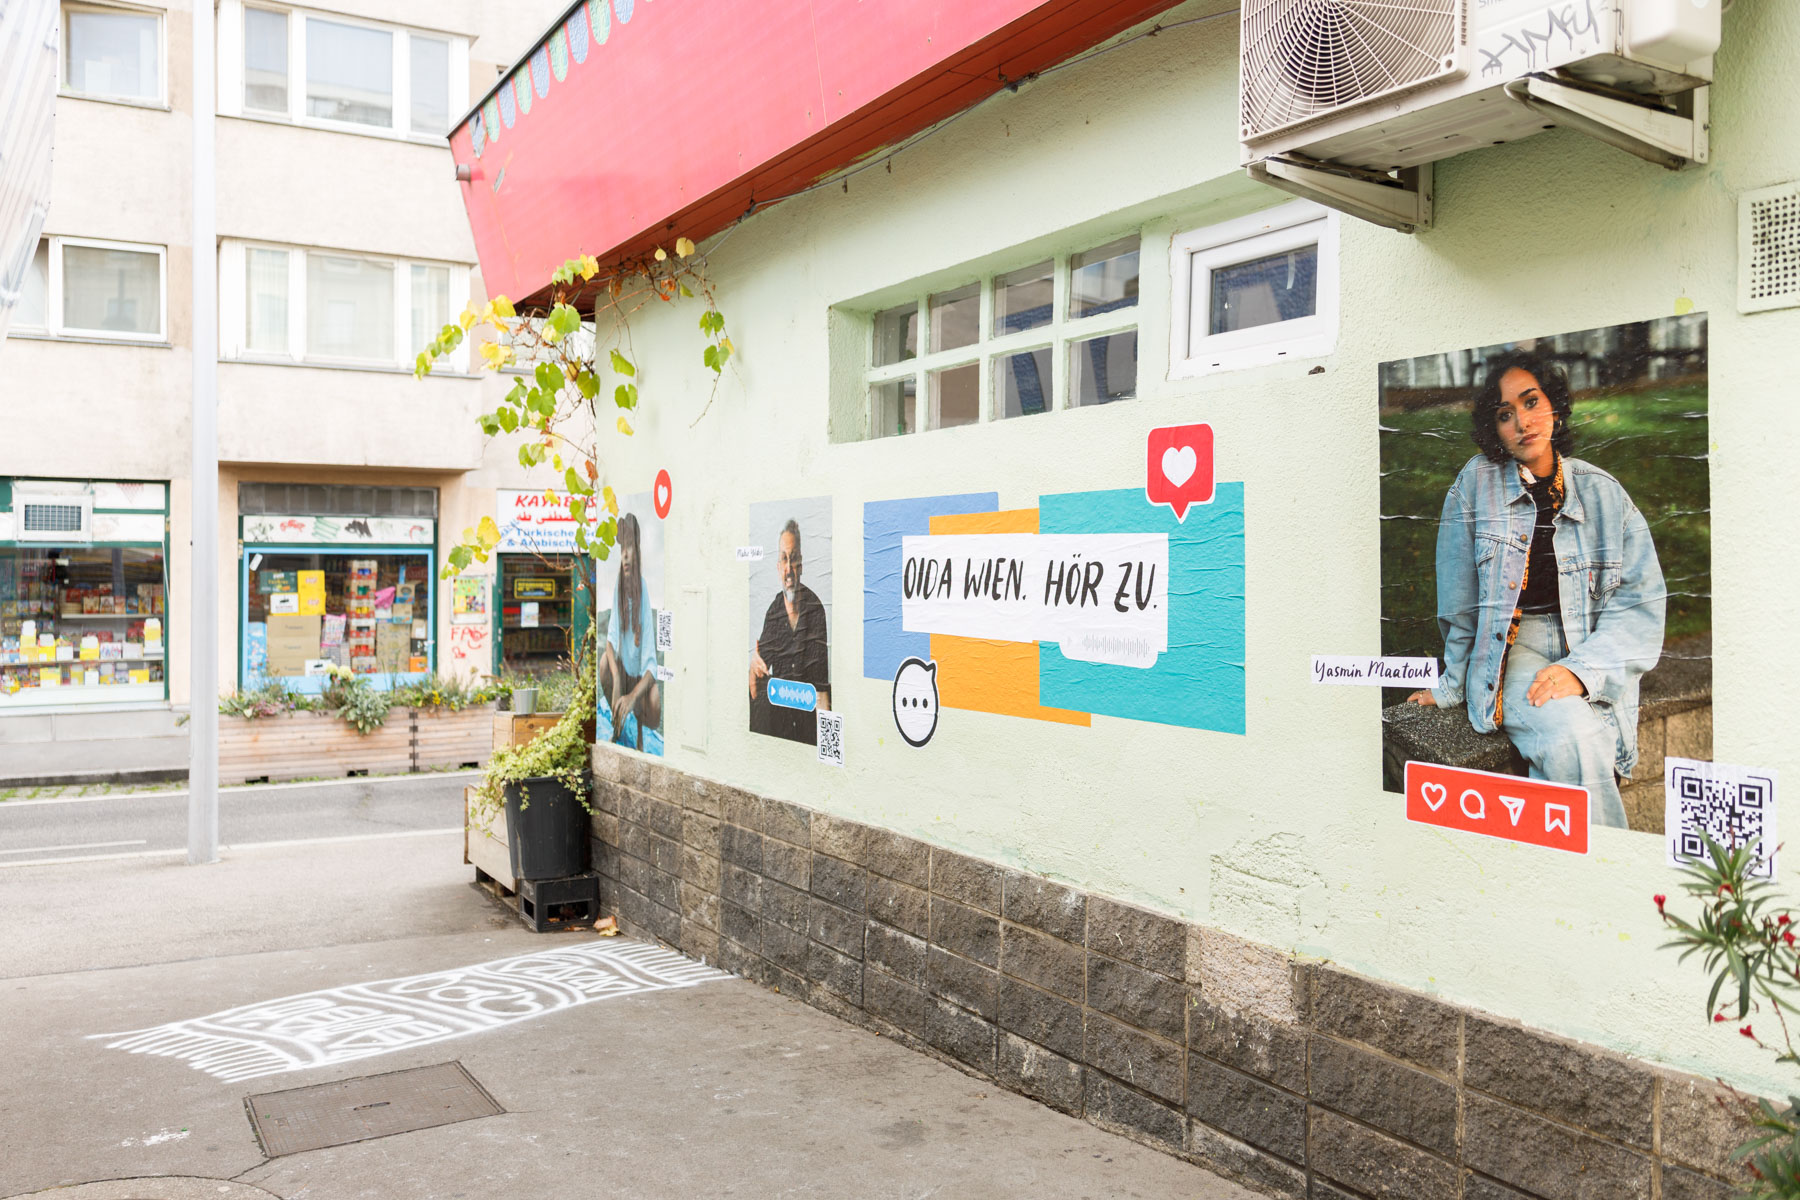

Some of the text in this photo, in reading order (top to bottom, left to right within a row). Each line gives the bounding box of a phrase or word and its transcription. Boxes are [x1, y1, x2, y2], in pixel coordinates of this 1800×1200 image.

[517, 528, 575, 537] Türkische
[903, 553, 1158, 613] OIDA WIEN. HÖR ZU.
[1315, 659, 1432, 682] Yasmin Maatouk
